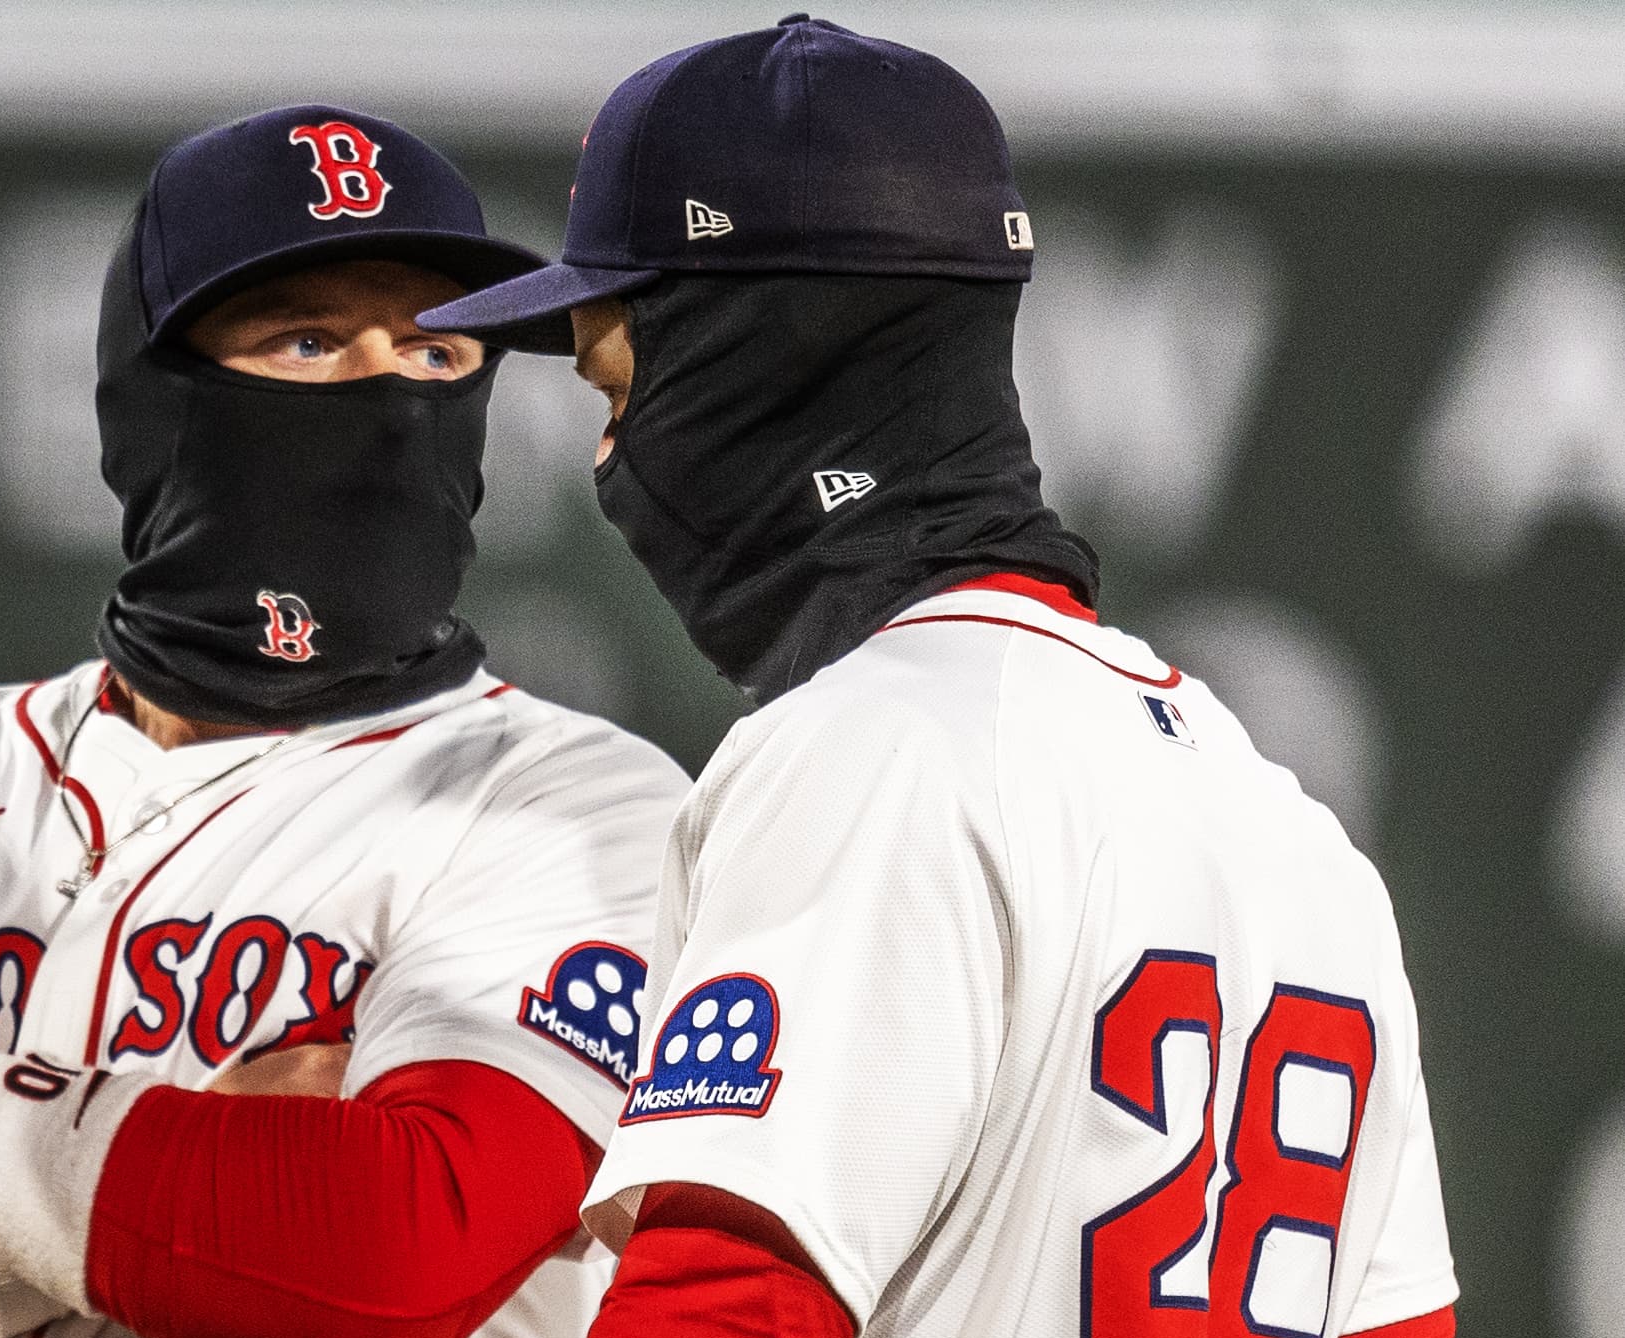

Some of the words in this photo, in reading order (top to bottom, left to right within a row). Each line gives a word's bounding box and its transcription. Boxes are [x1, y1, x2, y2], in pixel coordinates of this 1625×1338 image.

[289, 121, 393, 220] B
[256, 588, 322, 662] B
[529, 998, 638, 1085] MassMu
[628, 1076, 771, 1114] MassMutual
